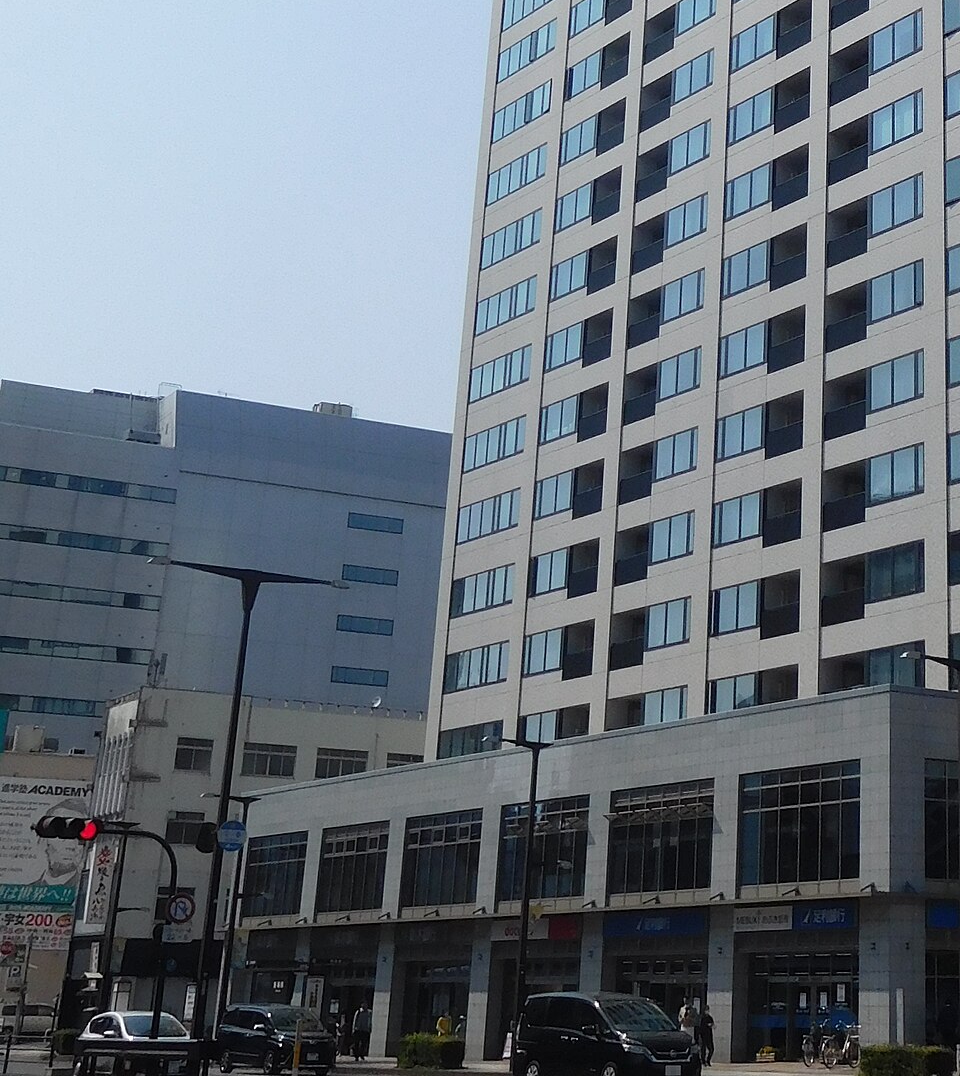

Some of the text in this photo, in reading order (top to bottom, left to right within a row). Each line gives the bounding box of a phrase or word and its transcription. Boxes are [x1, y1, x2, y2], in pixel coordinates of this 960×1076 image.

[27, 785, 88, 797] ACADEMY
[813, 908, 845, 924] 足利銀行
